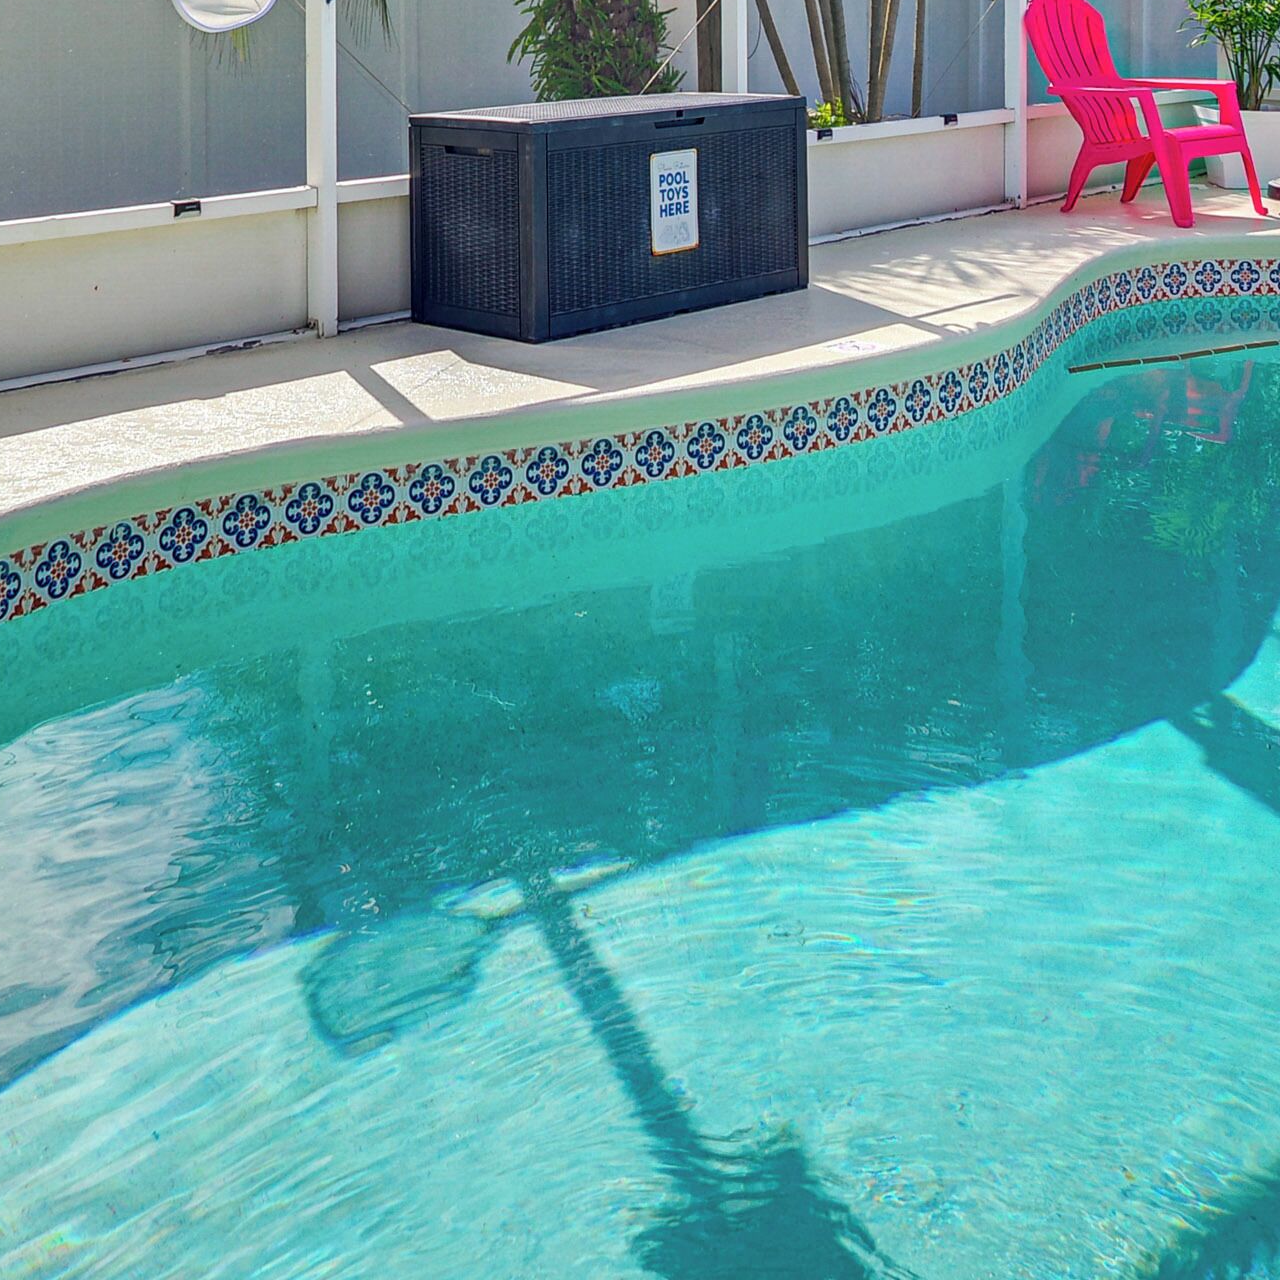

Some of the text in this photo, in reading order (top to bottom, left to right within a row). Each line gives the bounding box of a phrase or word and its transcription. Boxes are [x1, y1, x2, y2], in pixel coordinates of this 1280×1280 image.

[659, 171, 689, 187] POOL
[659, 187, 688, 202] TOYS
[659, 201, 689, 218] HERE
